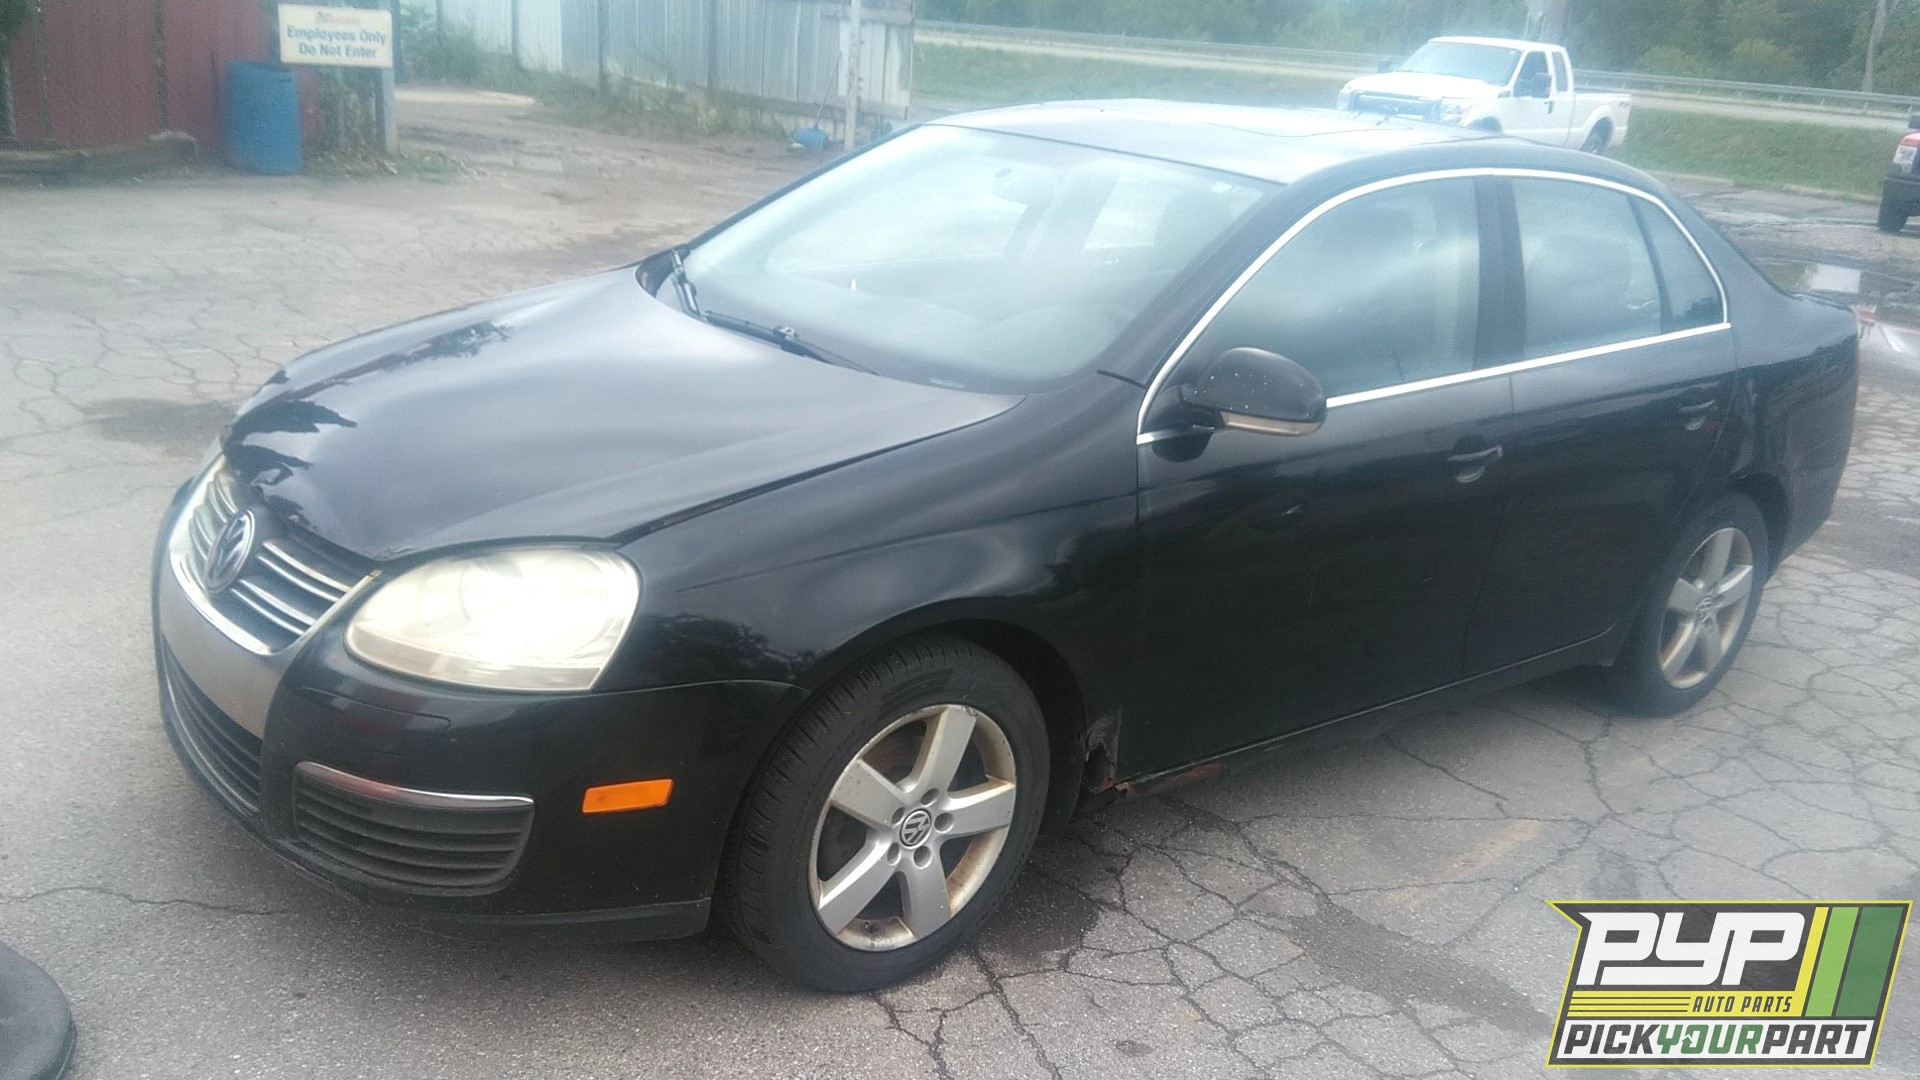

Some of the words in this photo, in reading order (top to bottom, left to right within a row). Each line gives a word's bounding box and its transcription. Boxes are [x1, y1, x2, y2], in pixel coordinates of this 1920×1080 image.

[286, 25, 356, 41] Employees
[360, 29, 386, 45] Only
[299, 42, 316, 55] Do
[320, 44, 342, 57] Not
[345, 46, 377, 59] Enter
